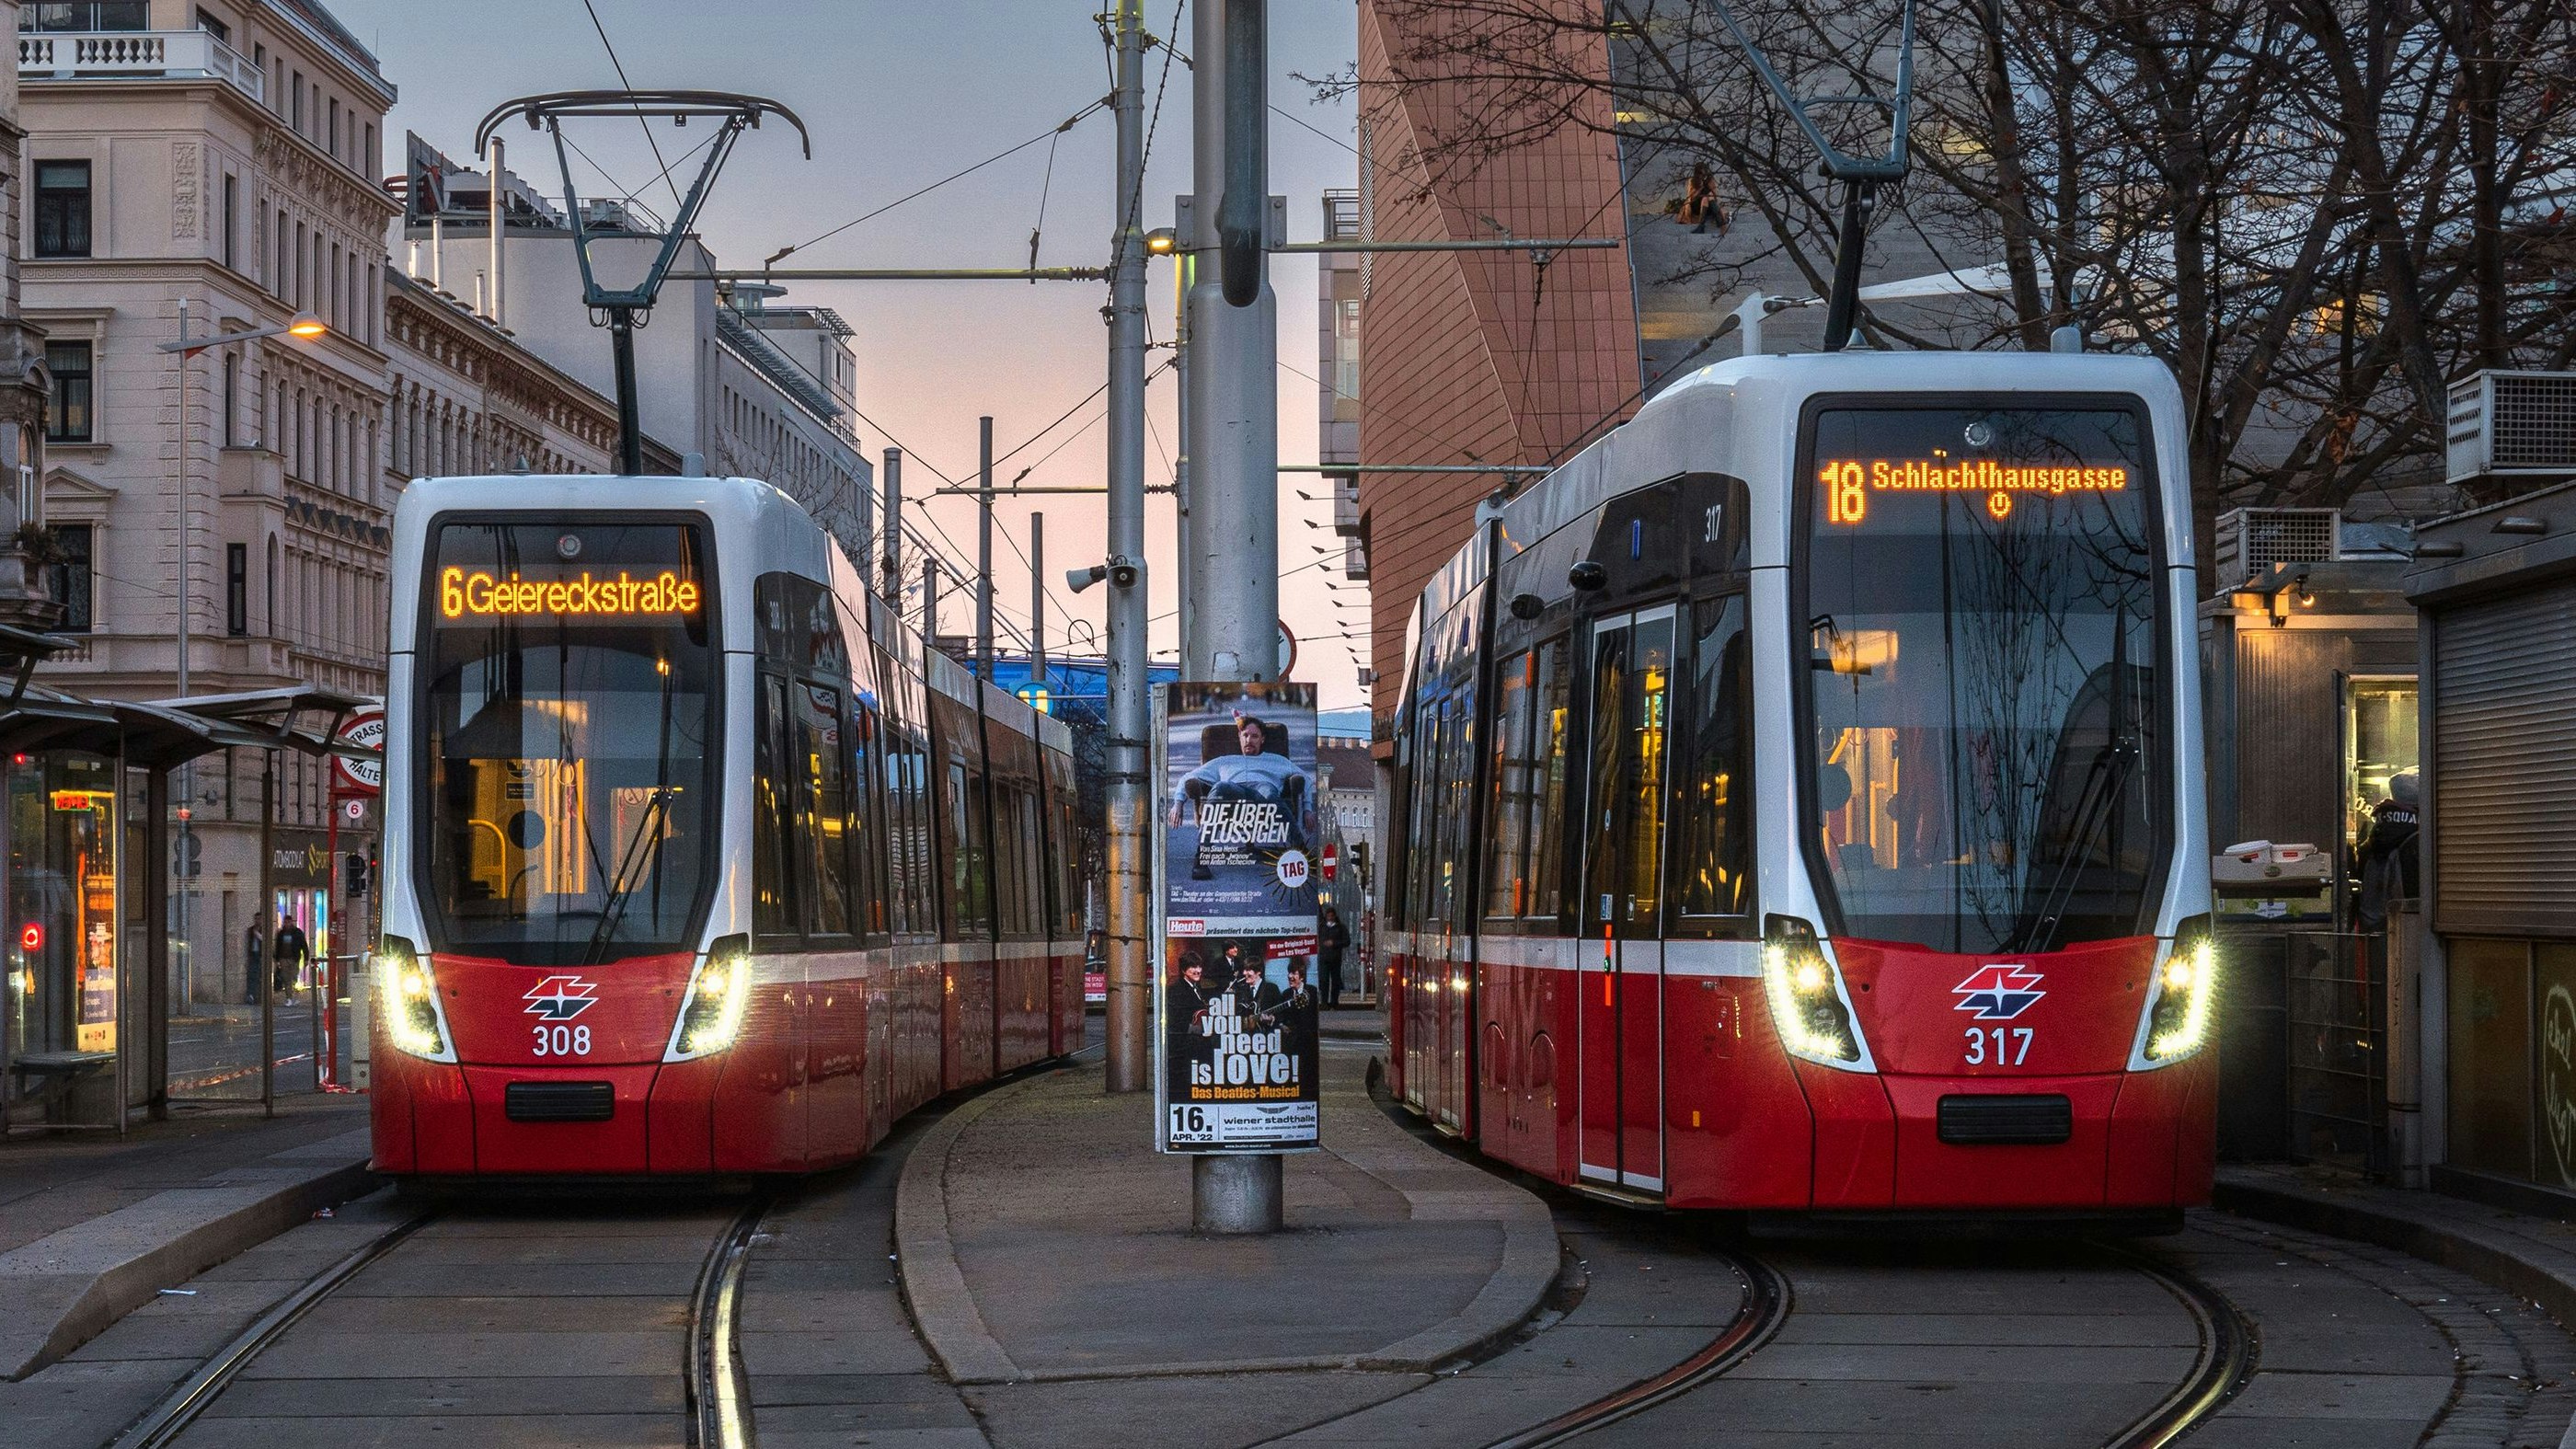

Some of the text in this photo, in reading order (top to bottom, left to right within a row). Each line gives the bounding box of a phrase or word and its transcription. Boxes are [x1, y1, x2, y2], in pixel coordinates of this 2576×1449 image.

[1820, 461, 2126, 523] 18 Schlachthausgasse
[1705, 504, 1721, 543] 317
[443, 567, 697, 618] 6 Geiereckstraße
[350, 723, 383, 742] TRASS
[349, 759, 381, 782] HALTE
[351, 804, 359, 815] 6
[1200, 799, 1282, 827] DIE ÜBER-
[1281, 860, 1305, 879] TAG
[1170, 920, 1203, 932] Heute
[1205, 927, 1242, 936] präsentiert
[1255, 926, 1280, 935] nächste
[1208, 994, 1236, 1016] all
[1201, 1015, 1242, 1037] you
[532, 1025, 592, 1056] 308
[1220, 1029, 1282, 1054] need
[1964, 1027, 2034, 1065] 317
[1190, 1048, 1299, 1086] is love!
[1191, 1086, 1300, 1099] Das Beatles-Musical
[1173, 1106, 1213, 1133] 16.
[1224, 1114, 1316, 1125] wiener stadthalle
